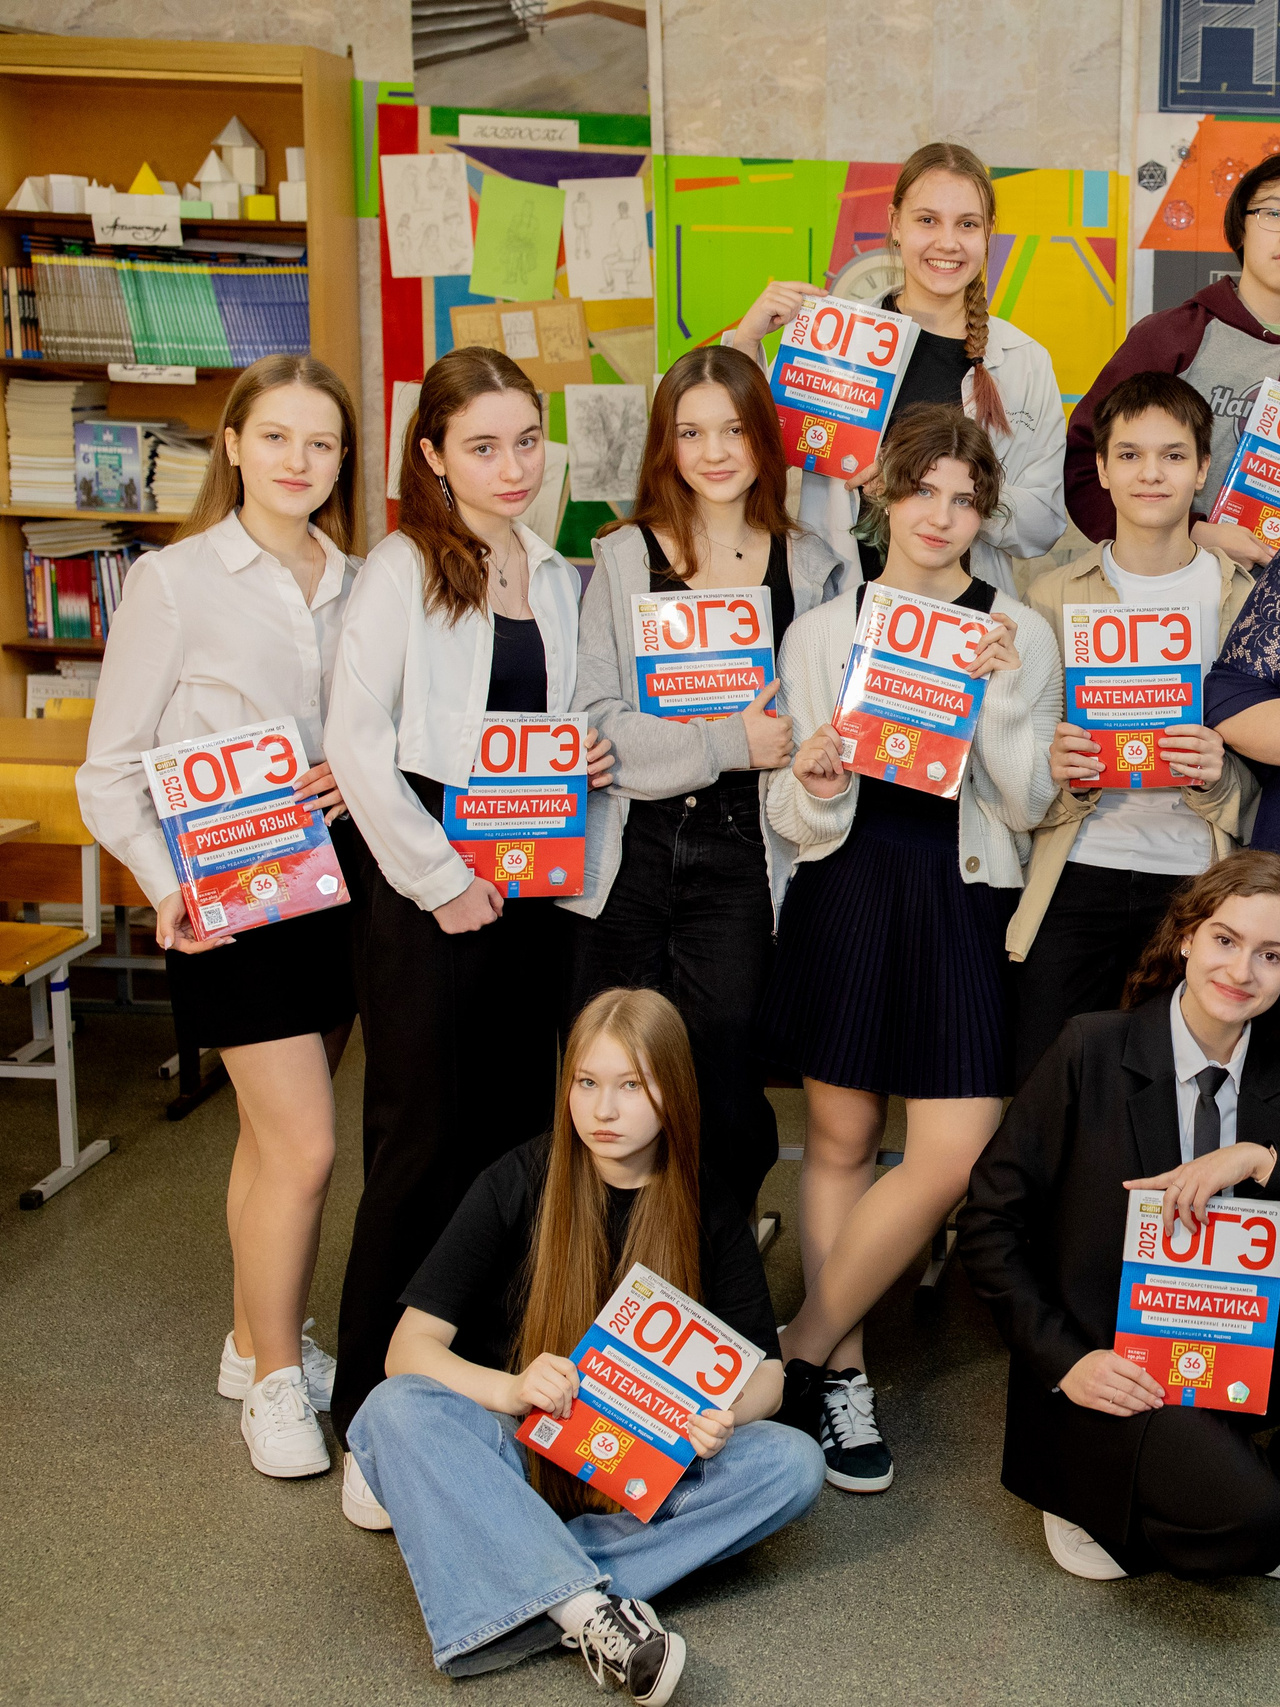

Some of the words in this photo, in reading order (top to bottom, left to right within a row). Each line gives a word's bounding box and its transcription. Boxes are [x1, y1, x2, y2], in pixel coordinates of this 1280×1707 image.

[791, 314, 809, 345] 2025
[810, 307, 899, 367] ОГЭ
[785, 369, 876, 405] МАТЕМАТИКА
[810, 429, 824, 441] 36
[1256, 404, 1278, 436] 2025
[82, 453, 90, 464] 6
[1267, 520, 1280, 532] 36
[642, 619, 659, 652] 2025
[662, 600, 760, 650] ОГЭ
[887, 603, 990, 671] ОГЭ
[1092, 613, 1192, 663] ОГЭ
[1074, 631, 1089, 663] 2025
[653, 672, 759, 692] МАТЕМАТИКА
[1081, 688, 1186, 704] МАТЕМАТИКА
[481, 724, 580, 773] ОГЭ
[891, 737, 906, 750] 36
[1128, 745, 1142, 756] 36
[183, 734, 298, 802] ОГЭ
[163, 776, 187, 811] 2025
[463, 799, 571, 814] МАТЕМАТИКА
[196, 820, 255, 849] РУССКИЙ
[261, 811, 298, 835] ЯЗЫК
[507, 854, 522, 865] 36
[255, 878, 272, 892] 36
[1138, 1222, 1157, 1260] 2025
[1161, 1209, 1277, 1270] ОГЭ
[609, 1297, 641, 1335] 2025
[1138, 1289, 1260, 1317] МАТЕМАТИКА
[633, 1301, 742, 1396] ОГЭ
[1184, 1358, 1201, 1369] 36
[597, 1435, 613, 1453] 36
